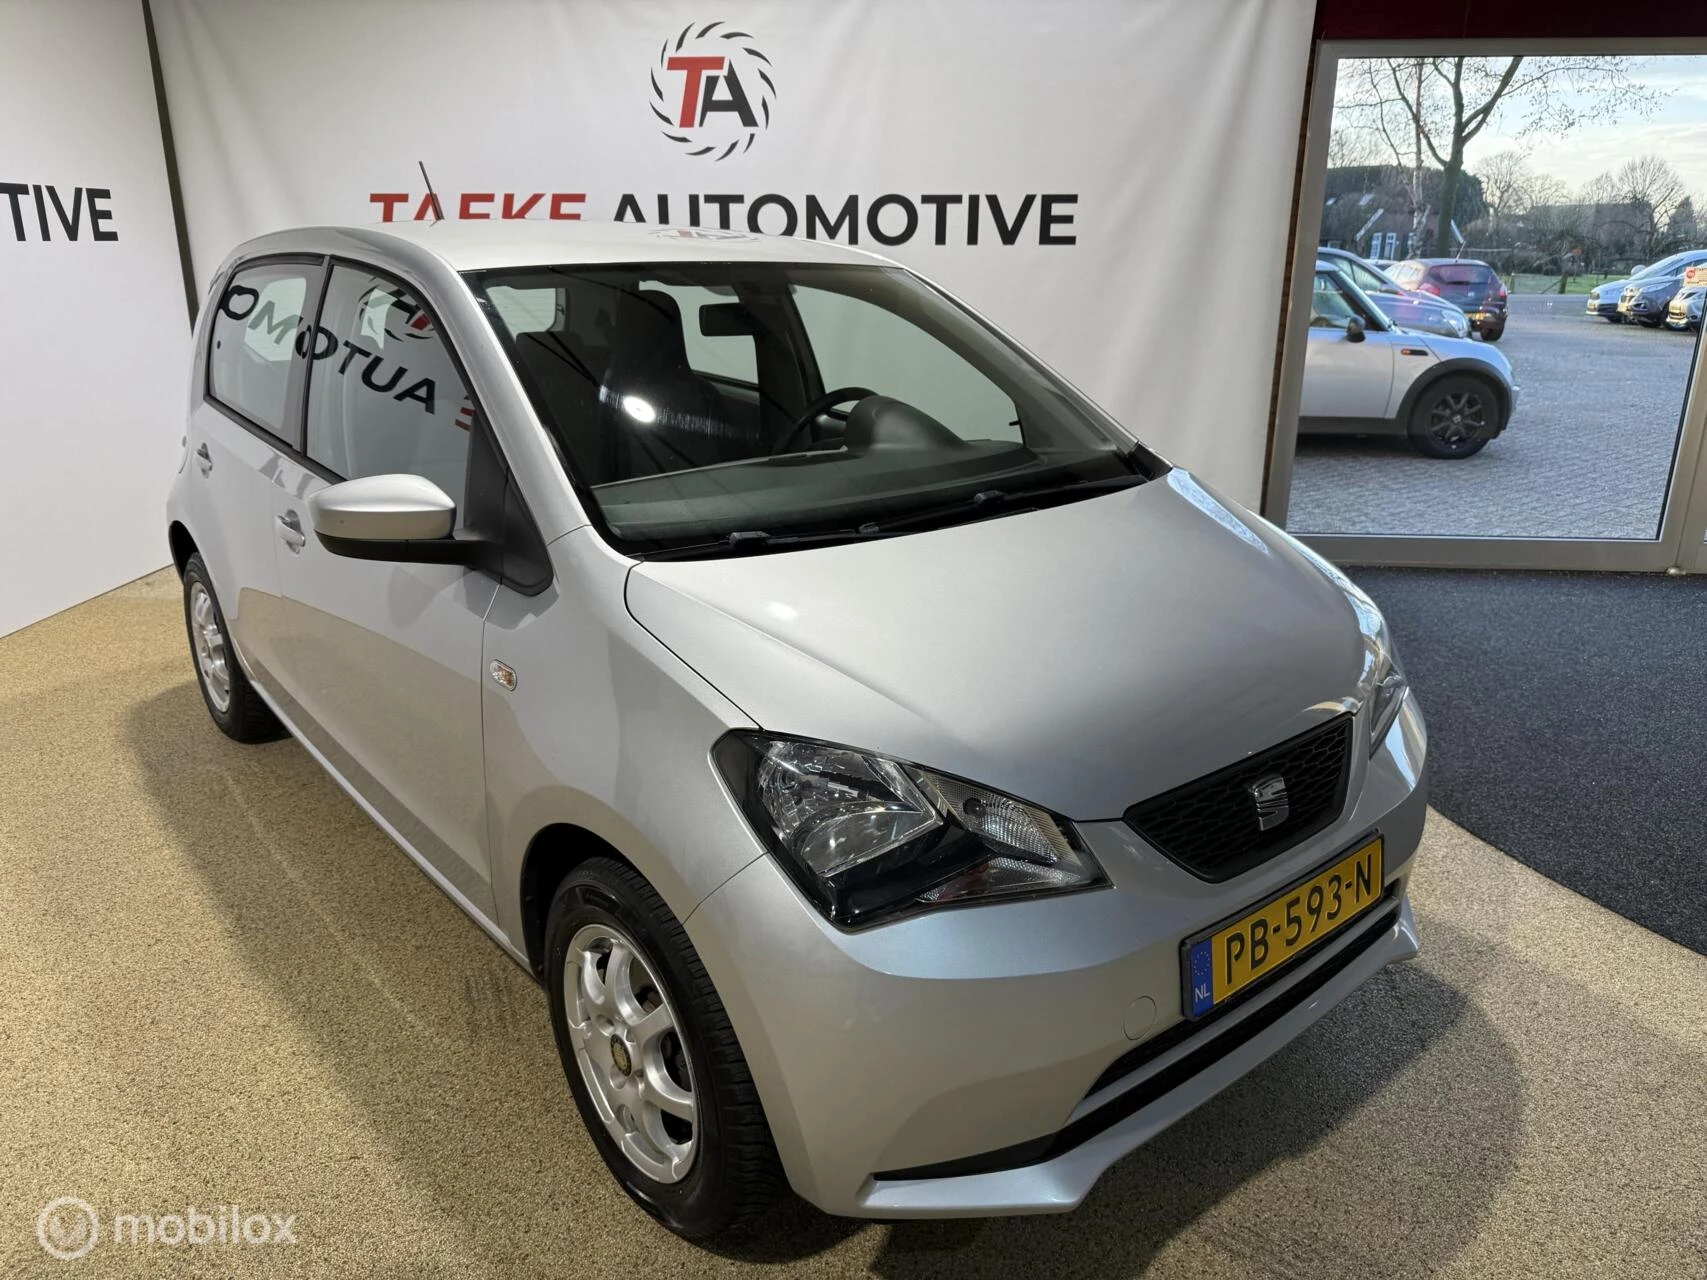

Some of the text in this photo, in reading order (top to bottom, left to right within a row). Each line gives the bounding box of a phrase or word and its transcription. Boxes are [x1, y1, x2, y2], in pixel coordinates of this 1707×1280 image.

[667, 56, 759, 128] TA
[0, 182, 119, 241] TIVE
[613, 193, 1079, 246] AUTOMOTIVE
[1225, 853, 1373, 986] PB-593-N
[1194, 986, 1211, 1003] NL
